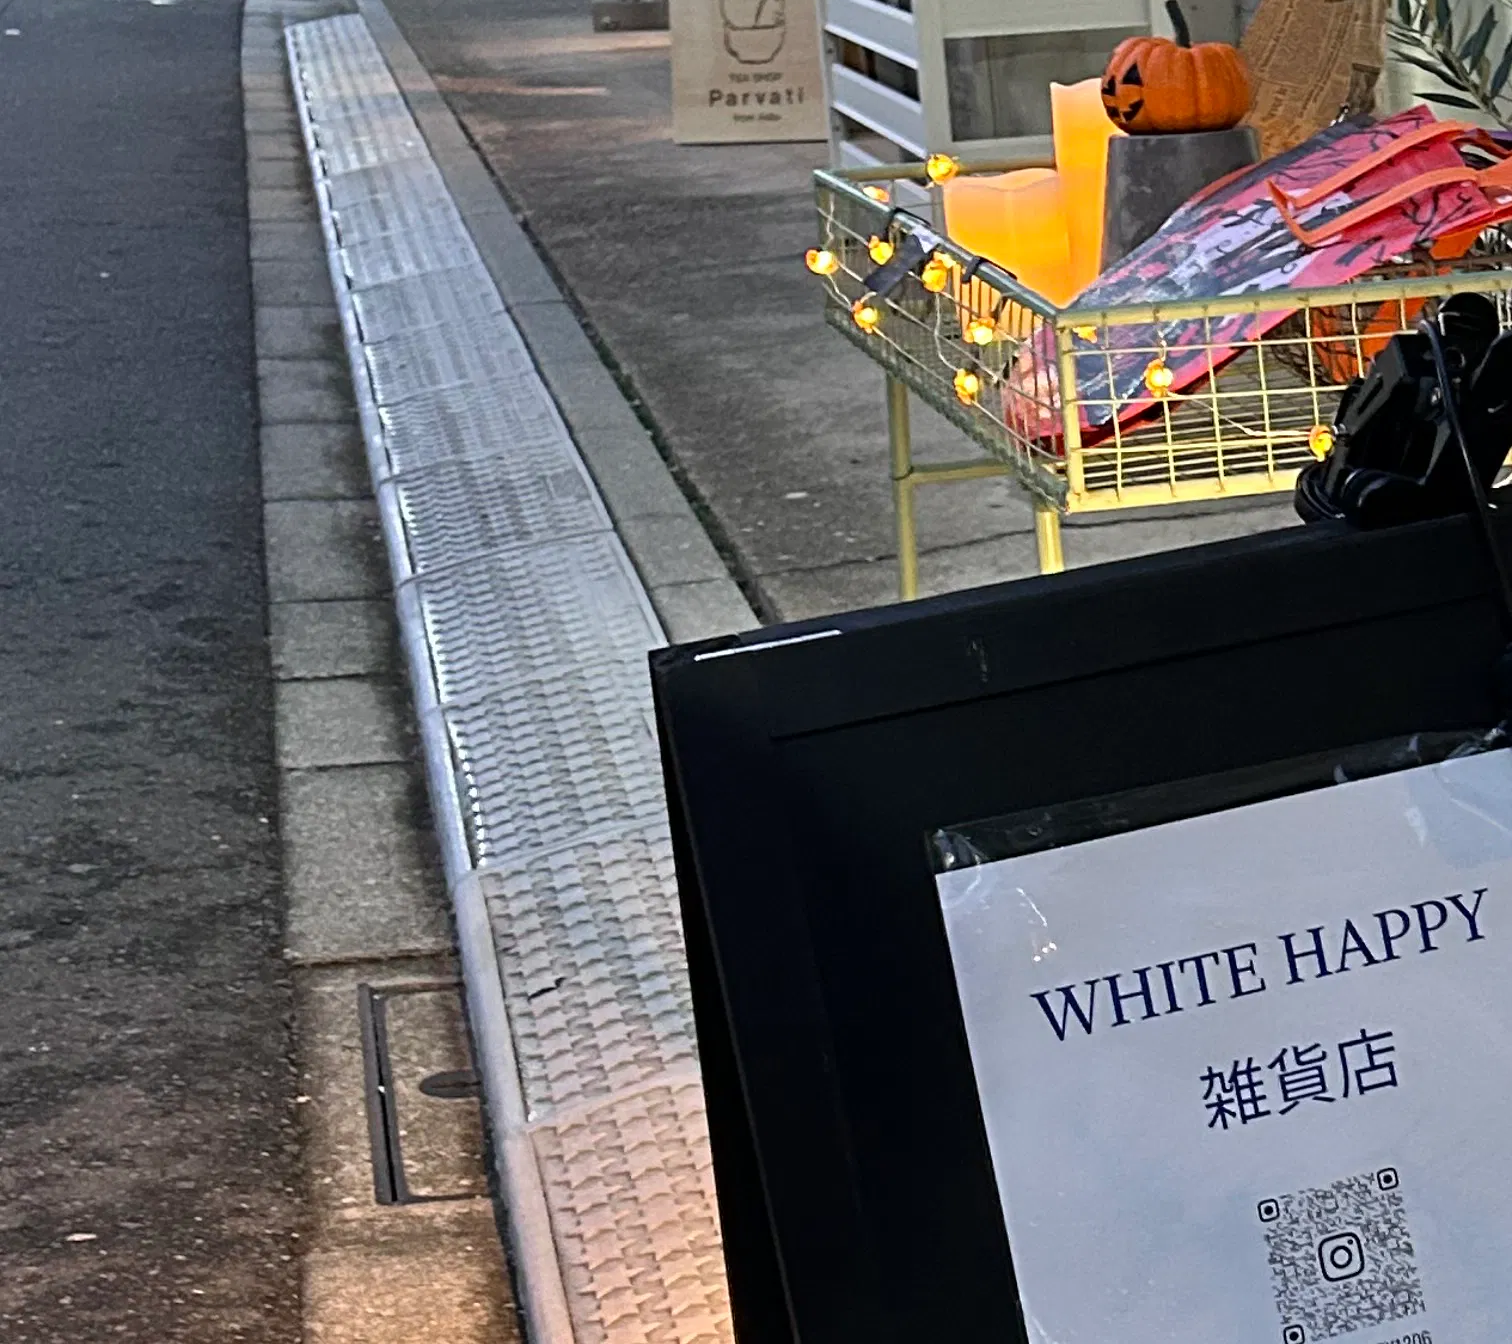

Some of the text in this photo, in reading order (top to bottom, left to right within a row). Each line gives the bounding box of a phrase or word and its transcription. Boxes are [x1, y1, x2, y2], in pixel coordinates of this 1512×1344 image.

[708, 86, 804, 108] Parvati
[1030, 887, 1488, 1042] WHITE HAPPY
[1200, 1028, 1398, 1130] 雑貨店
